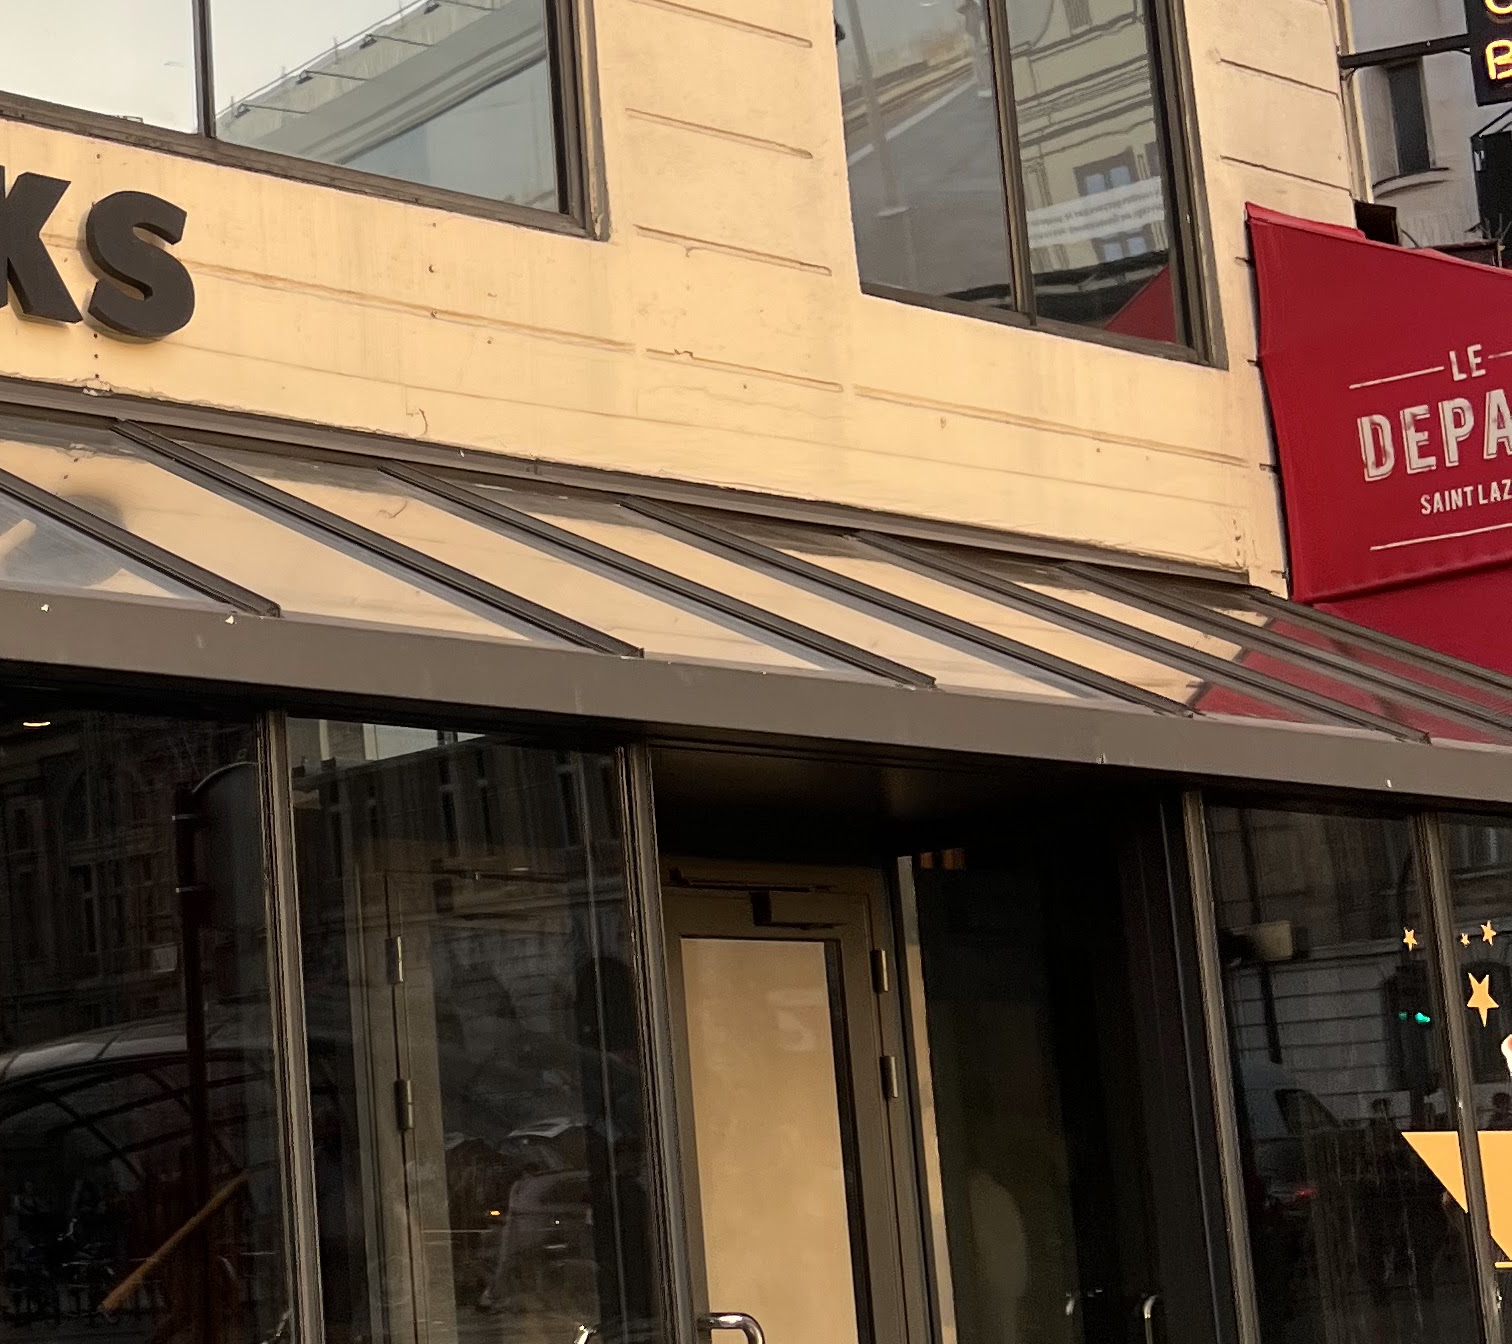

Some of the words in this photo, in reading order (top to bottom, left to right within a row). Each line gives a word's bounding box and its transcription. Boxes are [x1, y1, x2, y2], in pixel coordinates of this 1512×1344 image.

[1449, 344, 1486, 382] LE
[1420, 486, 1472, 515] SAINT
[1477, 479, 1512, 506] LAZ
